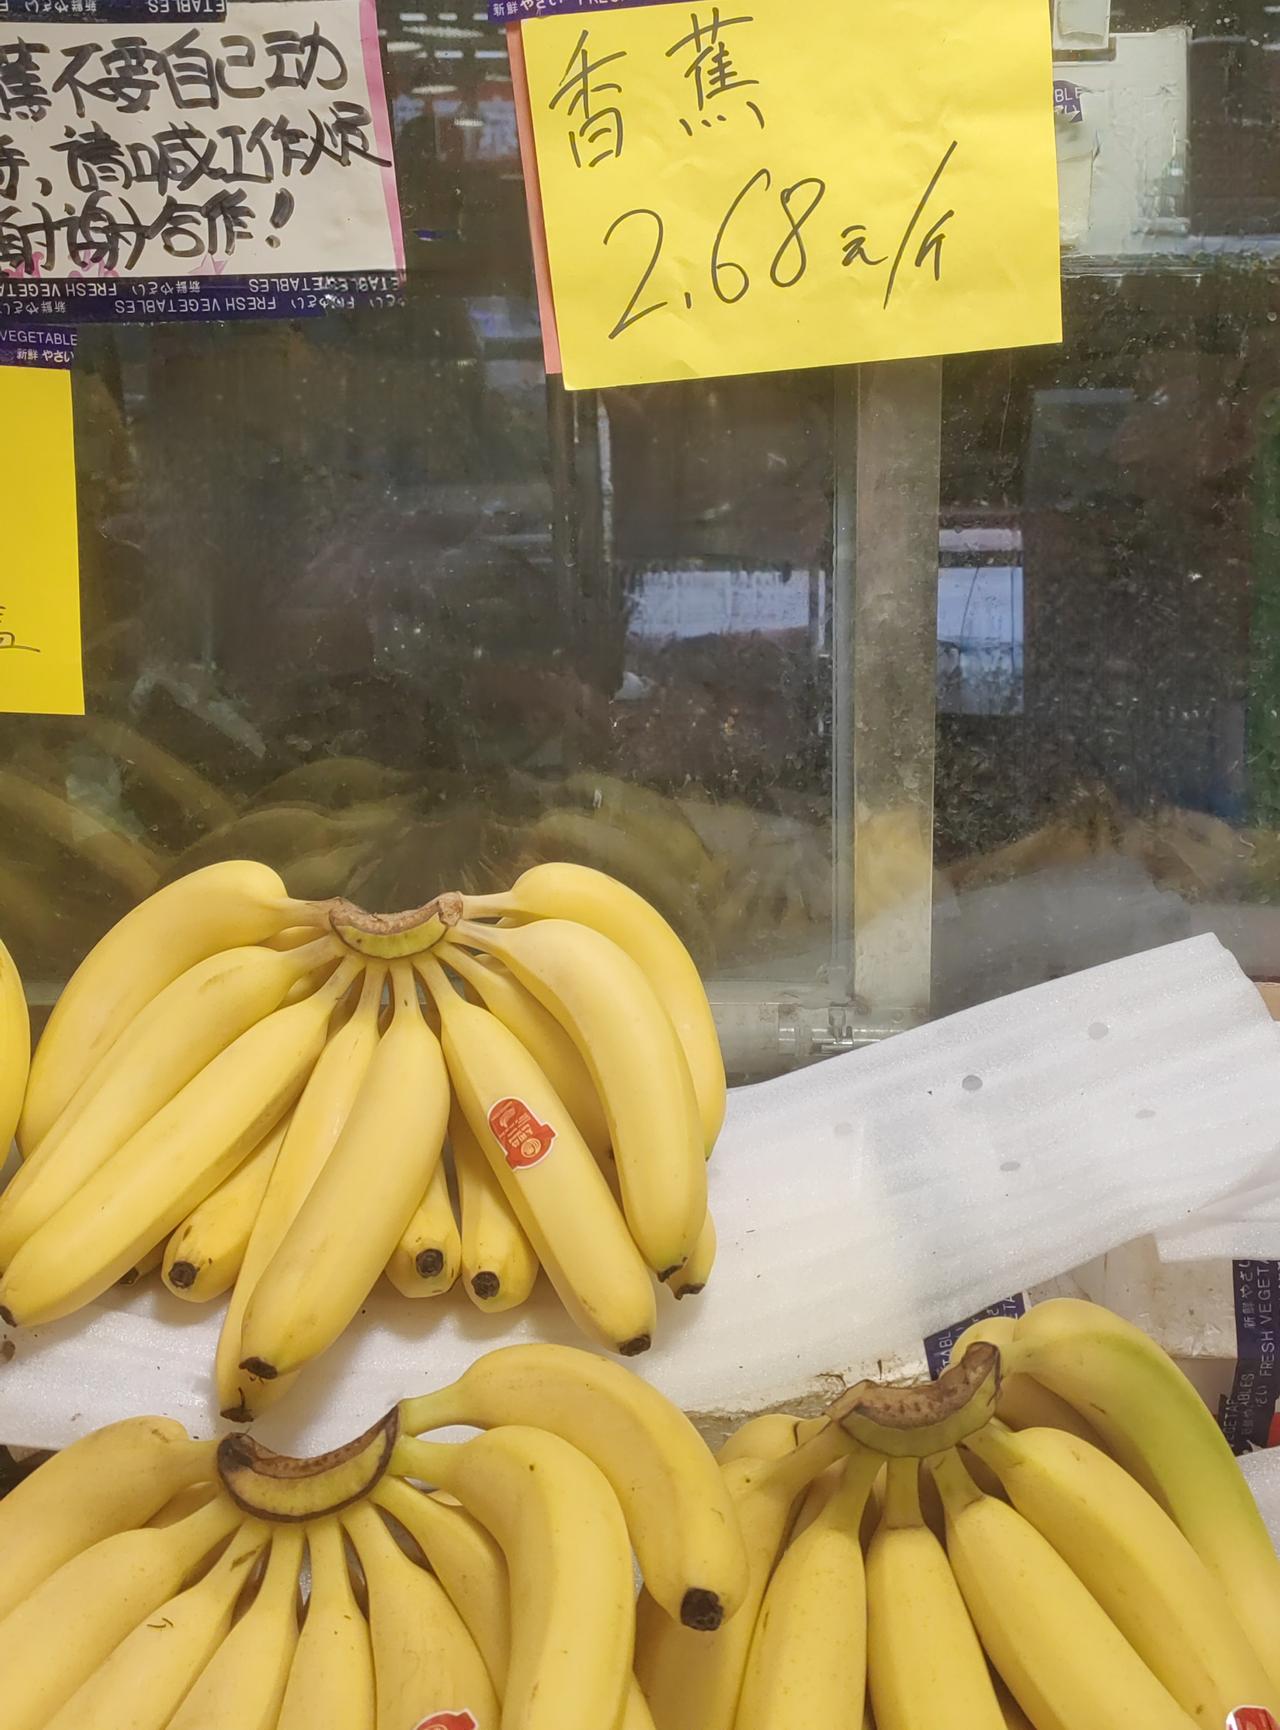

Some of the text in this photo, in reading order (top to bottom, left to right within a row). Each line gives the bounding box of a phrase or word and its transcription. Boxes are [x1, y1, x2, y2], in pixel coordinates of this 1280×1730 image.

[548, 7, 766, 168] 香蕉
[65, 283, 117, 297] FRESH
[115, 297, 277, 314] FRESH VEGETABLES
[1260, 1330, 1275, 1377] FRESH
